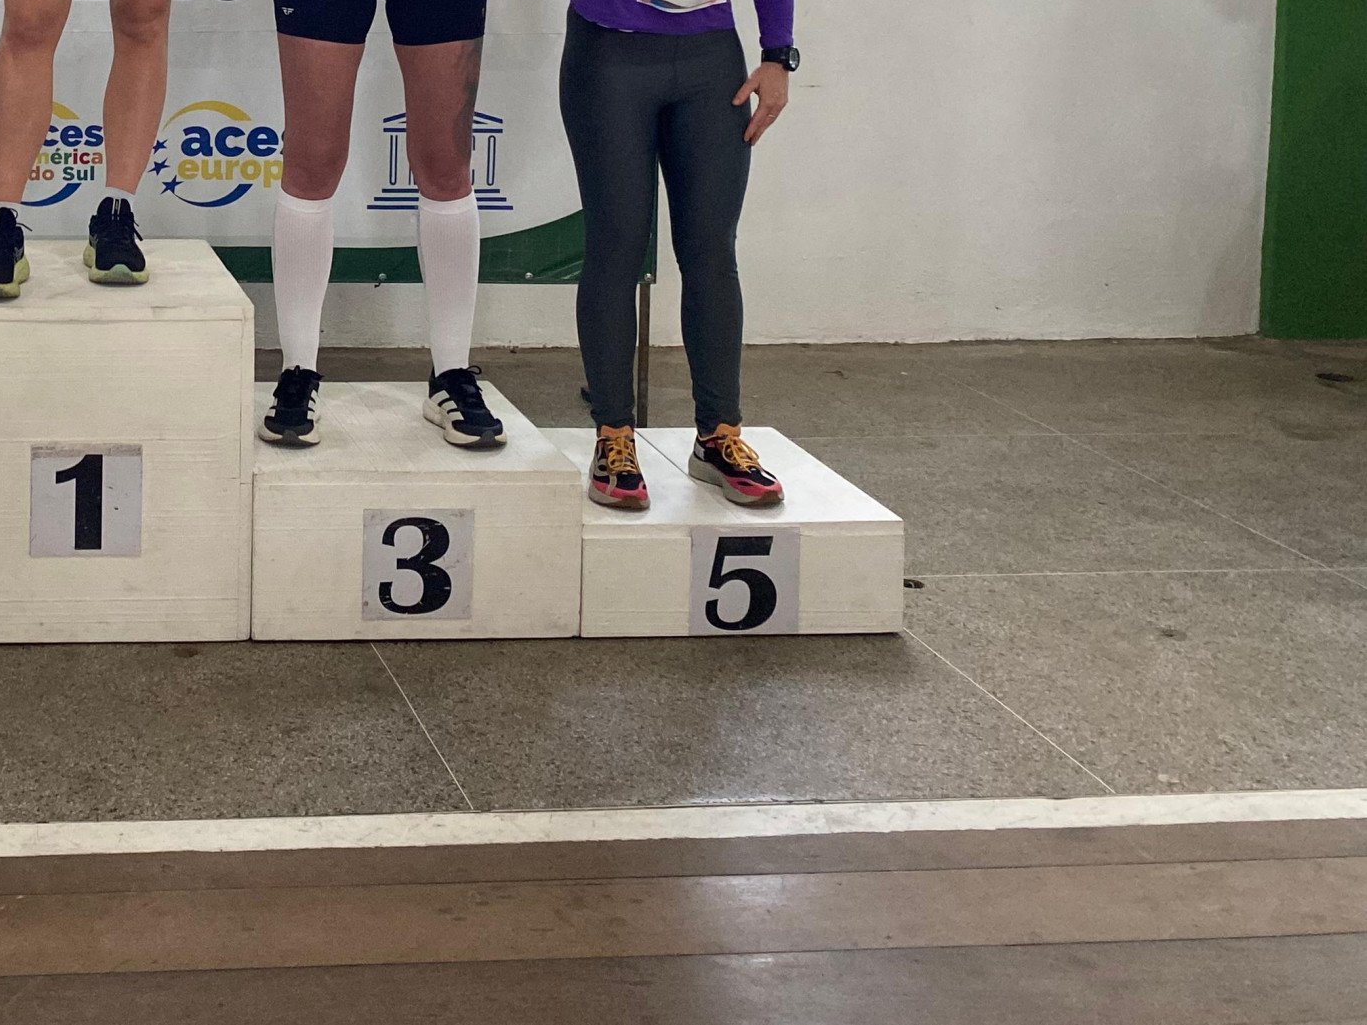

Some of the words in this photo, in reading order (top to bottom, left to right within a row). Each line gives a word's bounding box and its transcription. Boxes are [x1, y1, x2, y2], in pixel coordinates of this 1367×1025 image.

[28, 166, 54, 181] do
[62, 166, 95, 181] Sul
[181, 126, 285, 157] ace
[53, 453, 104, 551] 1
[377, 516, 452, 615] 3
[705, 535, 780, 631] 5
